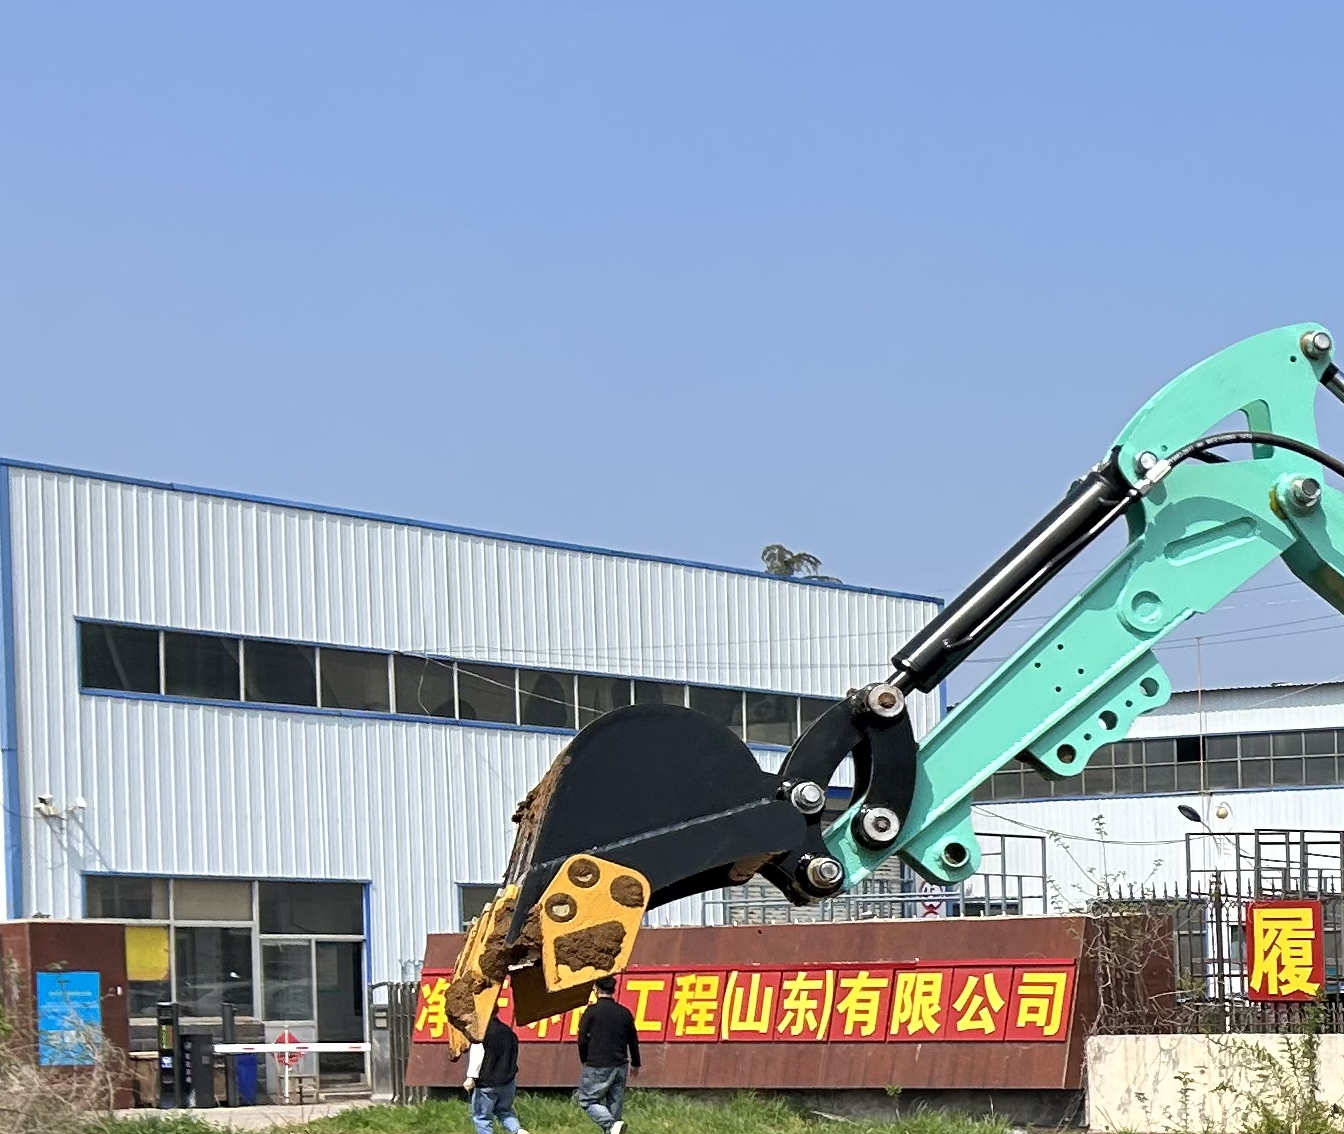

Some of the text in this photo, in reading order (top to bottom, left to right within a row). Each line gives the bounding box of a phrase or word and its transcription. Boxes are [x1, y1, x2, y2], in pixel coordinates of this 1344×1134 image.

[415, 969, 1068, 1041] 净工程(山东)有限公司
